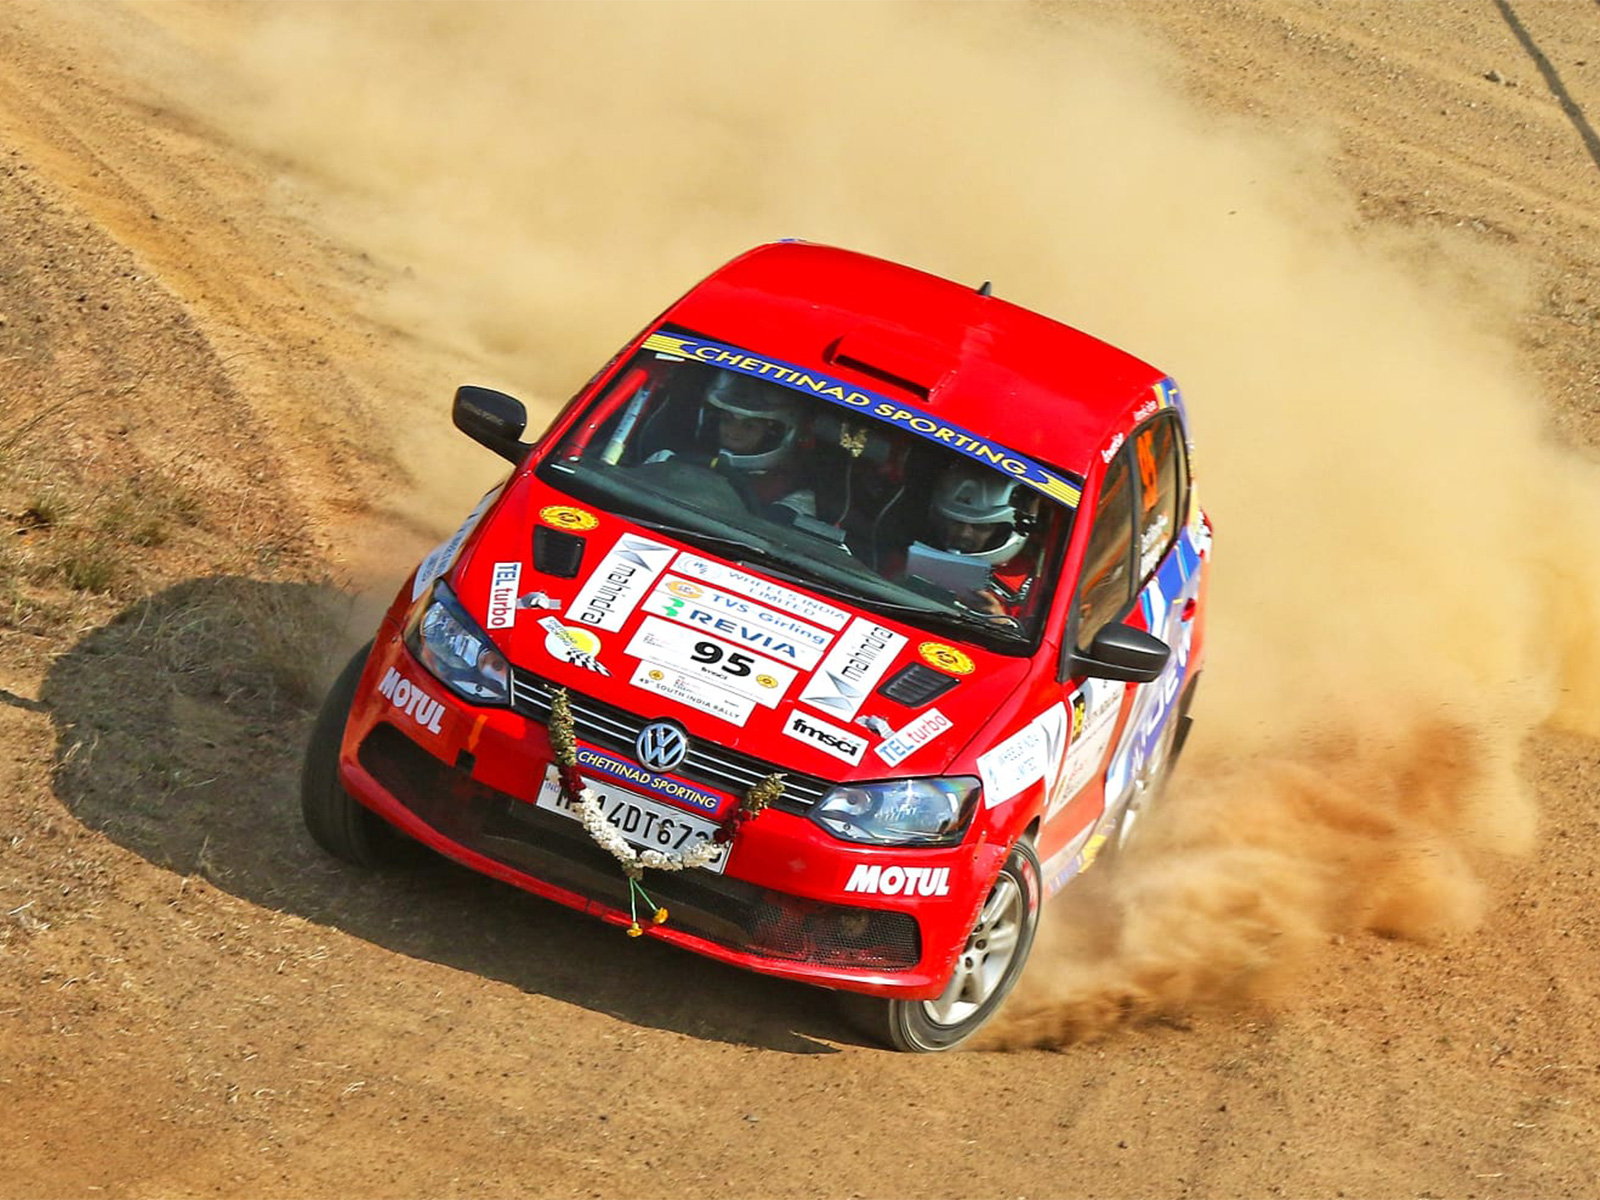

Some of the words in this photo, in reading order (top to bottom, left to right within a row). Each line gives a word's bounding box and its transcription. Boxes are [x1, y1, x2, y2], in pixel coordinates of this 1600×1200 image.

[694, 346, 871, 407] CHETTINAD
[874, 403, 1028, 476] SPORTING
[496, 563, 518, 586] TEL
[580, 563, 637, 625] mahindra
[729, 571, 797, 600] WHEELS
[801, 599, 846, 621] INDIA
[491, 587, 514, 626] turbo
[712, 593, 750, 614] TVS
[758, 611, 826, 646] Girling
[749, 586, 816, 617] LIMITED
[689, 608, 797, 659] REVIA
[840, 626, 894, 682] mahindra
[690, 640, 756, 678] 95
[377, 665, 447, 735] MOTUL
[656, 682, 685, 699] SOUTH
[686, 694, 711, 708] INDIA
[713, 704, 741, 719] RALLY
[879, 737, 915, 763] TEL
[905, 713, 948, 745] turbo
[578, 750, 652, 785] CHETTINAD
[651, 778, 718, 810] SPORTING
[844, 864, 951, 897] MOTUL
